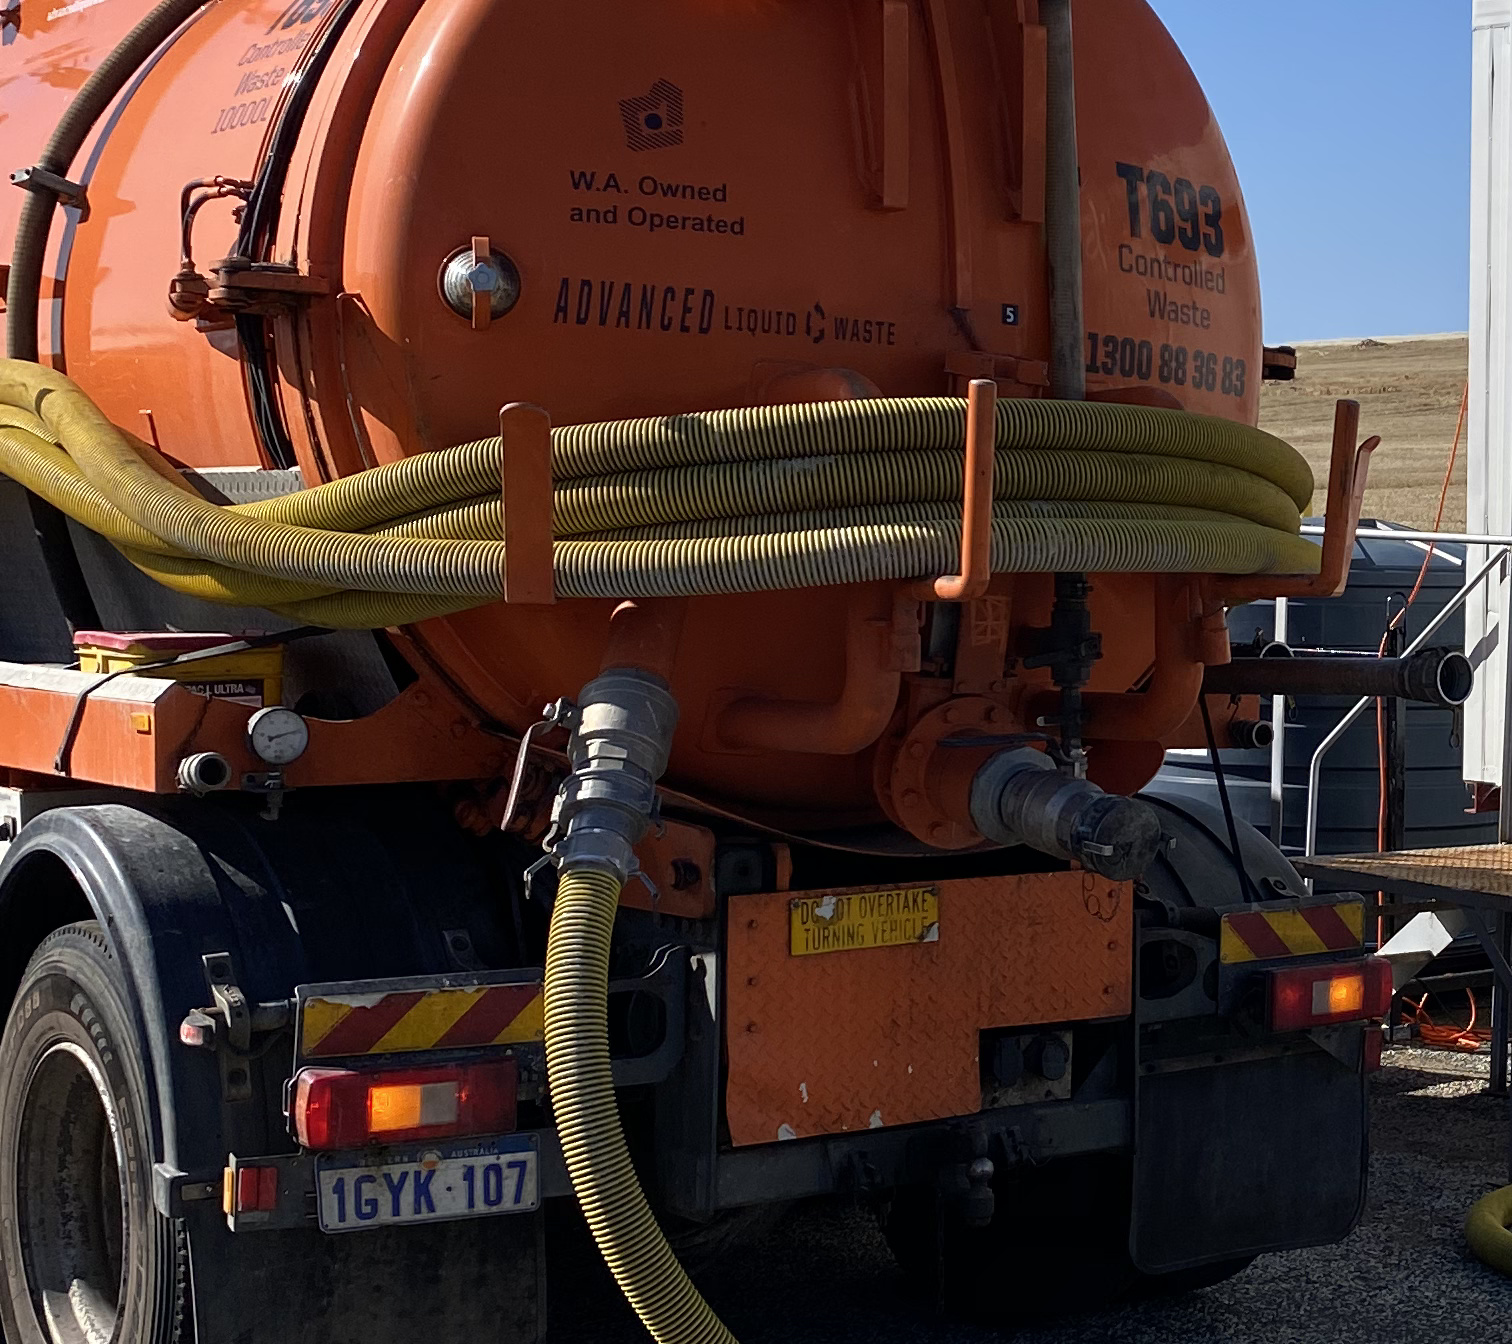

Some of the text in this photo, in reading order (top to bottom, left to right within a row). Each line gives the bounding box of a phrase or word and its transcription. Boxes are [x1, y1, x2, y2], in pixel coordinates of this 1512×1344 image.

[237, 29, 312, 67] Controlle
[234, 65, 286, 97] Waste
[569, 170, 728, 202] W.A. Owned
[569, 205, 746, 236] and Operated
[1115, 161, 1225, 258] T693
[1118, 243, 1226, 295] Controlled
[553, 277, 897, 346] ADVANCED LIQUID WASTE
[1006, 307, 1015, 323] 5
[1146, 288, 1211, 330] Waste
[1085, 332, 1246, 397] 1300 88 36 83
[214, 684, 244, 695] ULTRA
[859, 890, 929, 919] OVERTAKE
[804, 923, 865, 952] TURNING
[451, 1147, 499, 1157] AUSTRALIA
[332, 1160, 527, 1224] 1GYK 107
